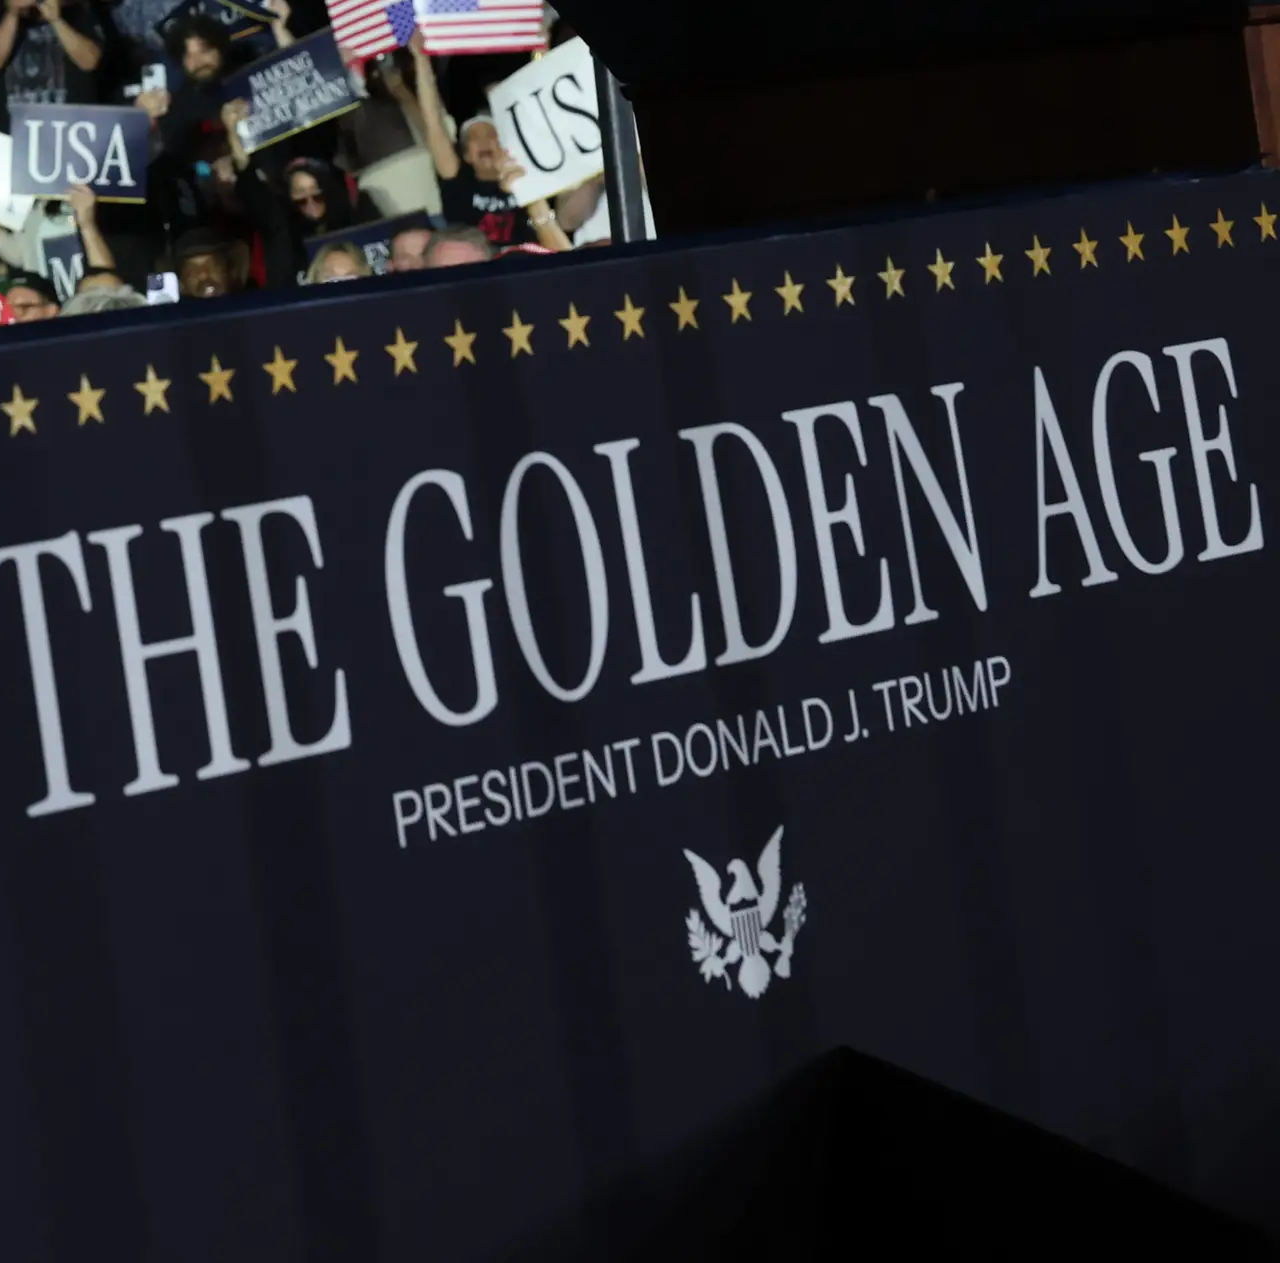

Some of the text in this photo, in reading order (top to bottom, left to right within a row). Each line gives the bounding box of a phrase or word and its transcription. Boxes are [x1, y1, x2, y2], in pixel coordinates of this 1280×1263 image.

[23, 118, 137, 187] USA
[505, 72, 603, 173] US
[383, 382, 990, 728] GOLDEN
[1028, 336, 1266, 598] AGE
[392, 656, 1014, 849] PRESIDENT DONALD J. TRUMP
